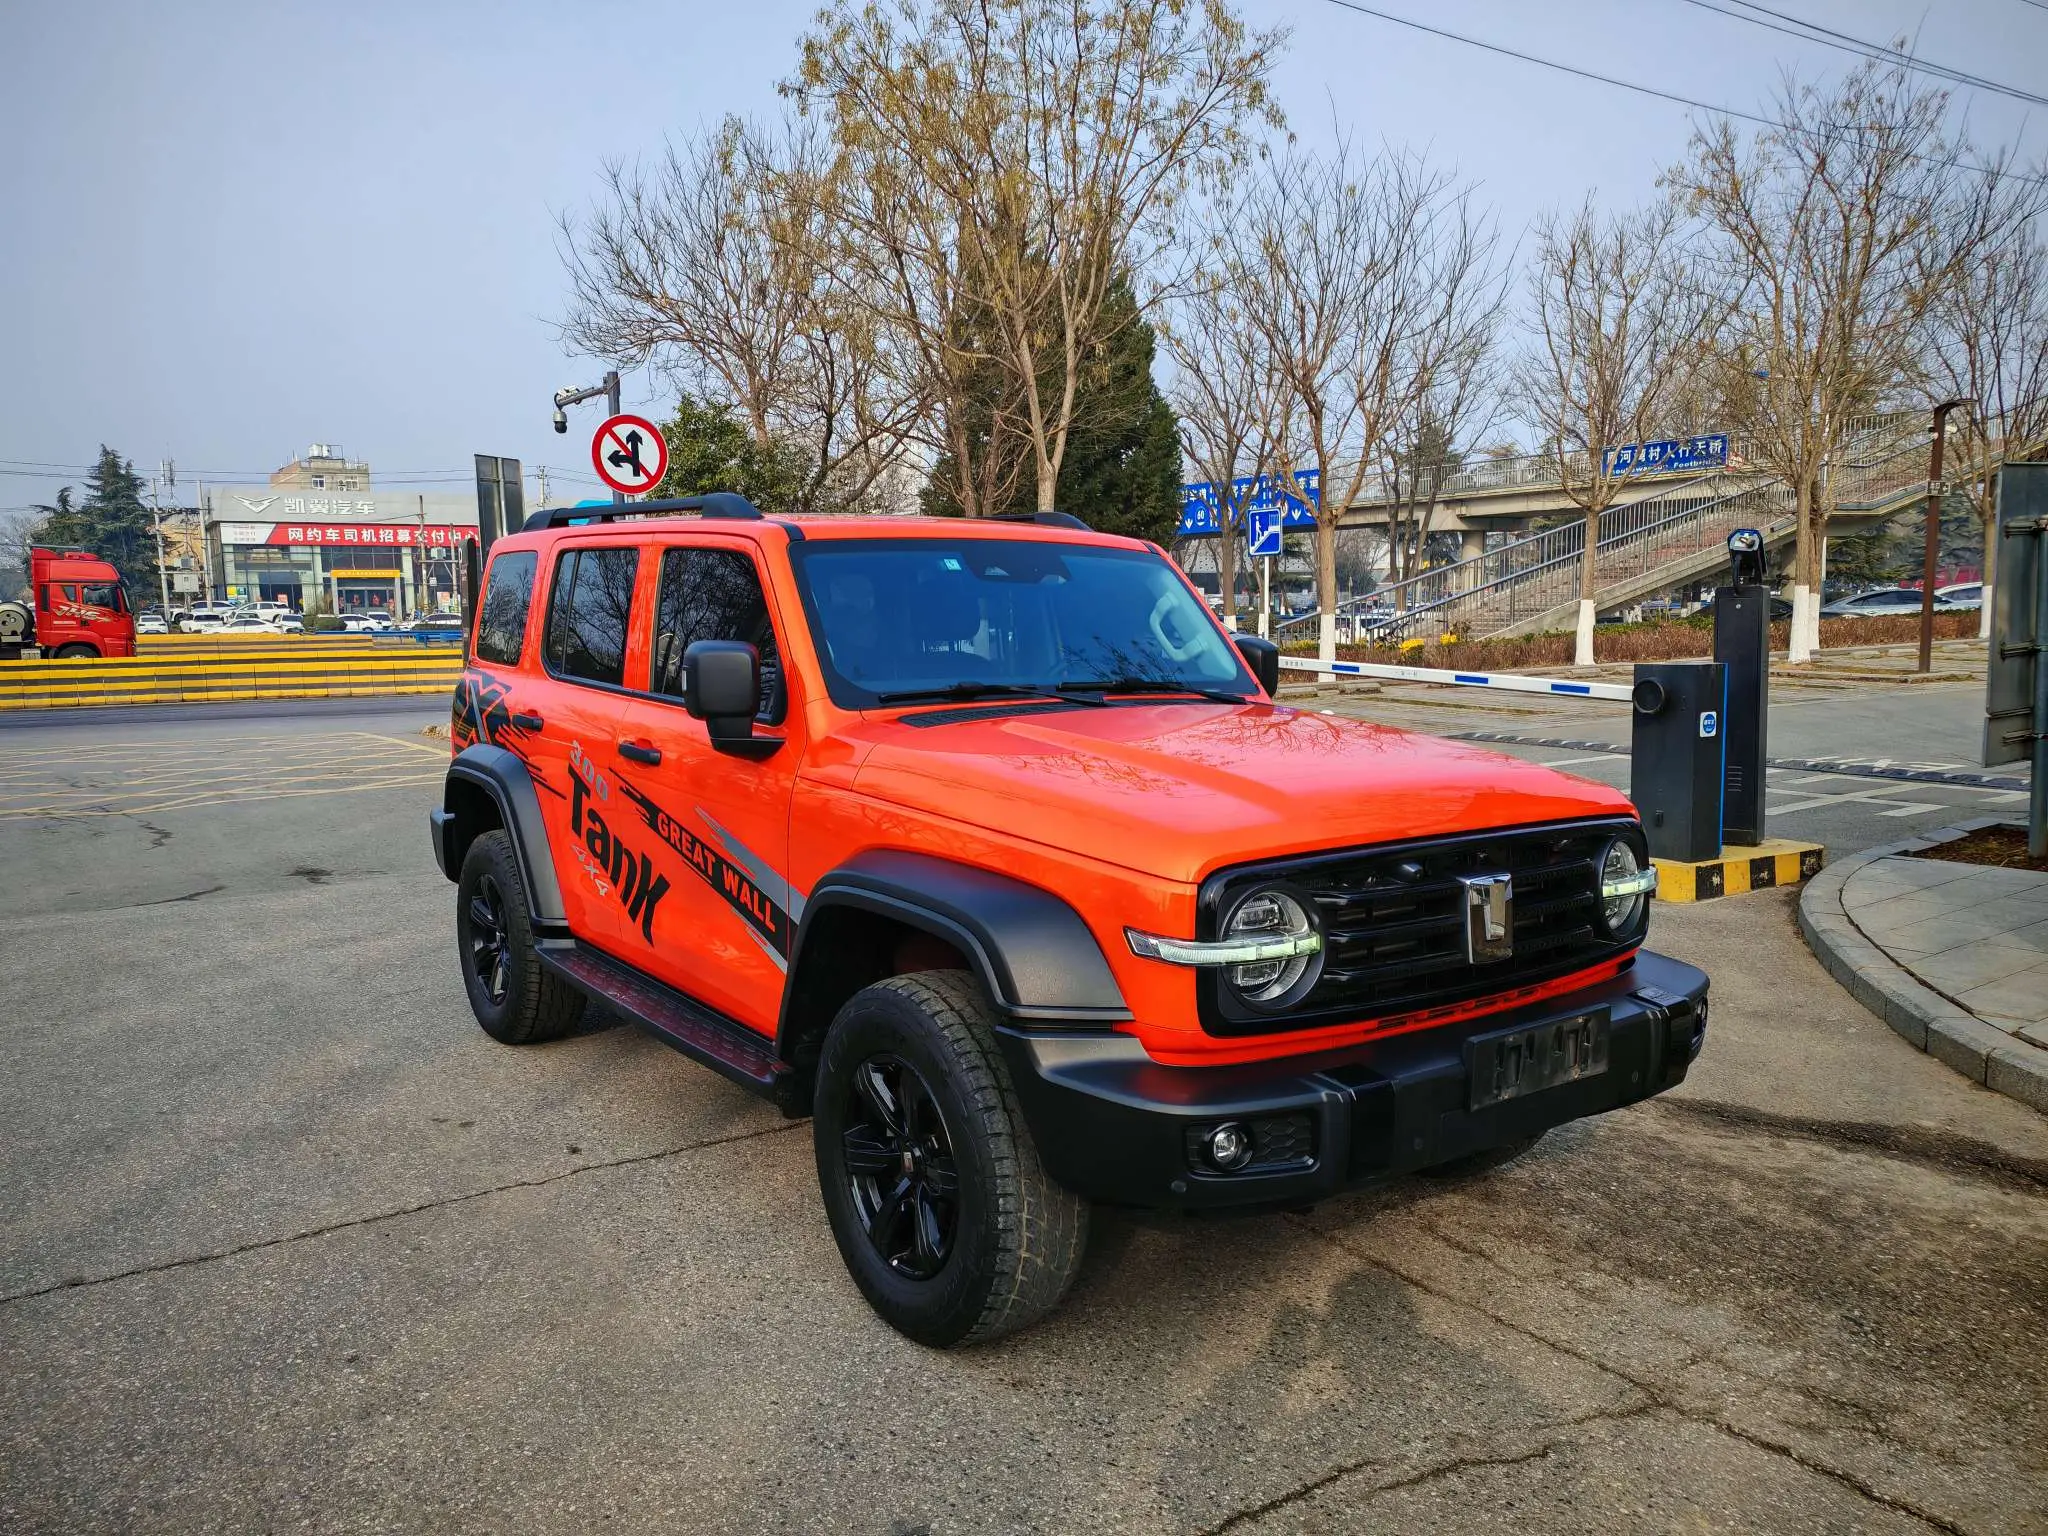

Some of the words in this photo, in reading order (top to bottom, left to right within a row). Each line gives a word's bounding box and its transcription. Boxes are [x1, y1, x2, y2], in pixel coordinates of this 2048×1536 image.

[284, 498, 376, 515] 凯翼汽车
[1197, 509, 1205, 521] 60
[288, 527, 480, 544] 网约车司机招募交付中心
[569, 739, 609, 801] 300
[568, 762, 671, 948] Tank
[657, 813, 716, 877] GREAT
[722, 863, 776, 933] WALL
